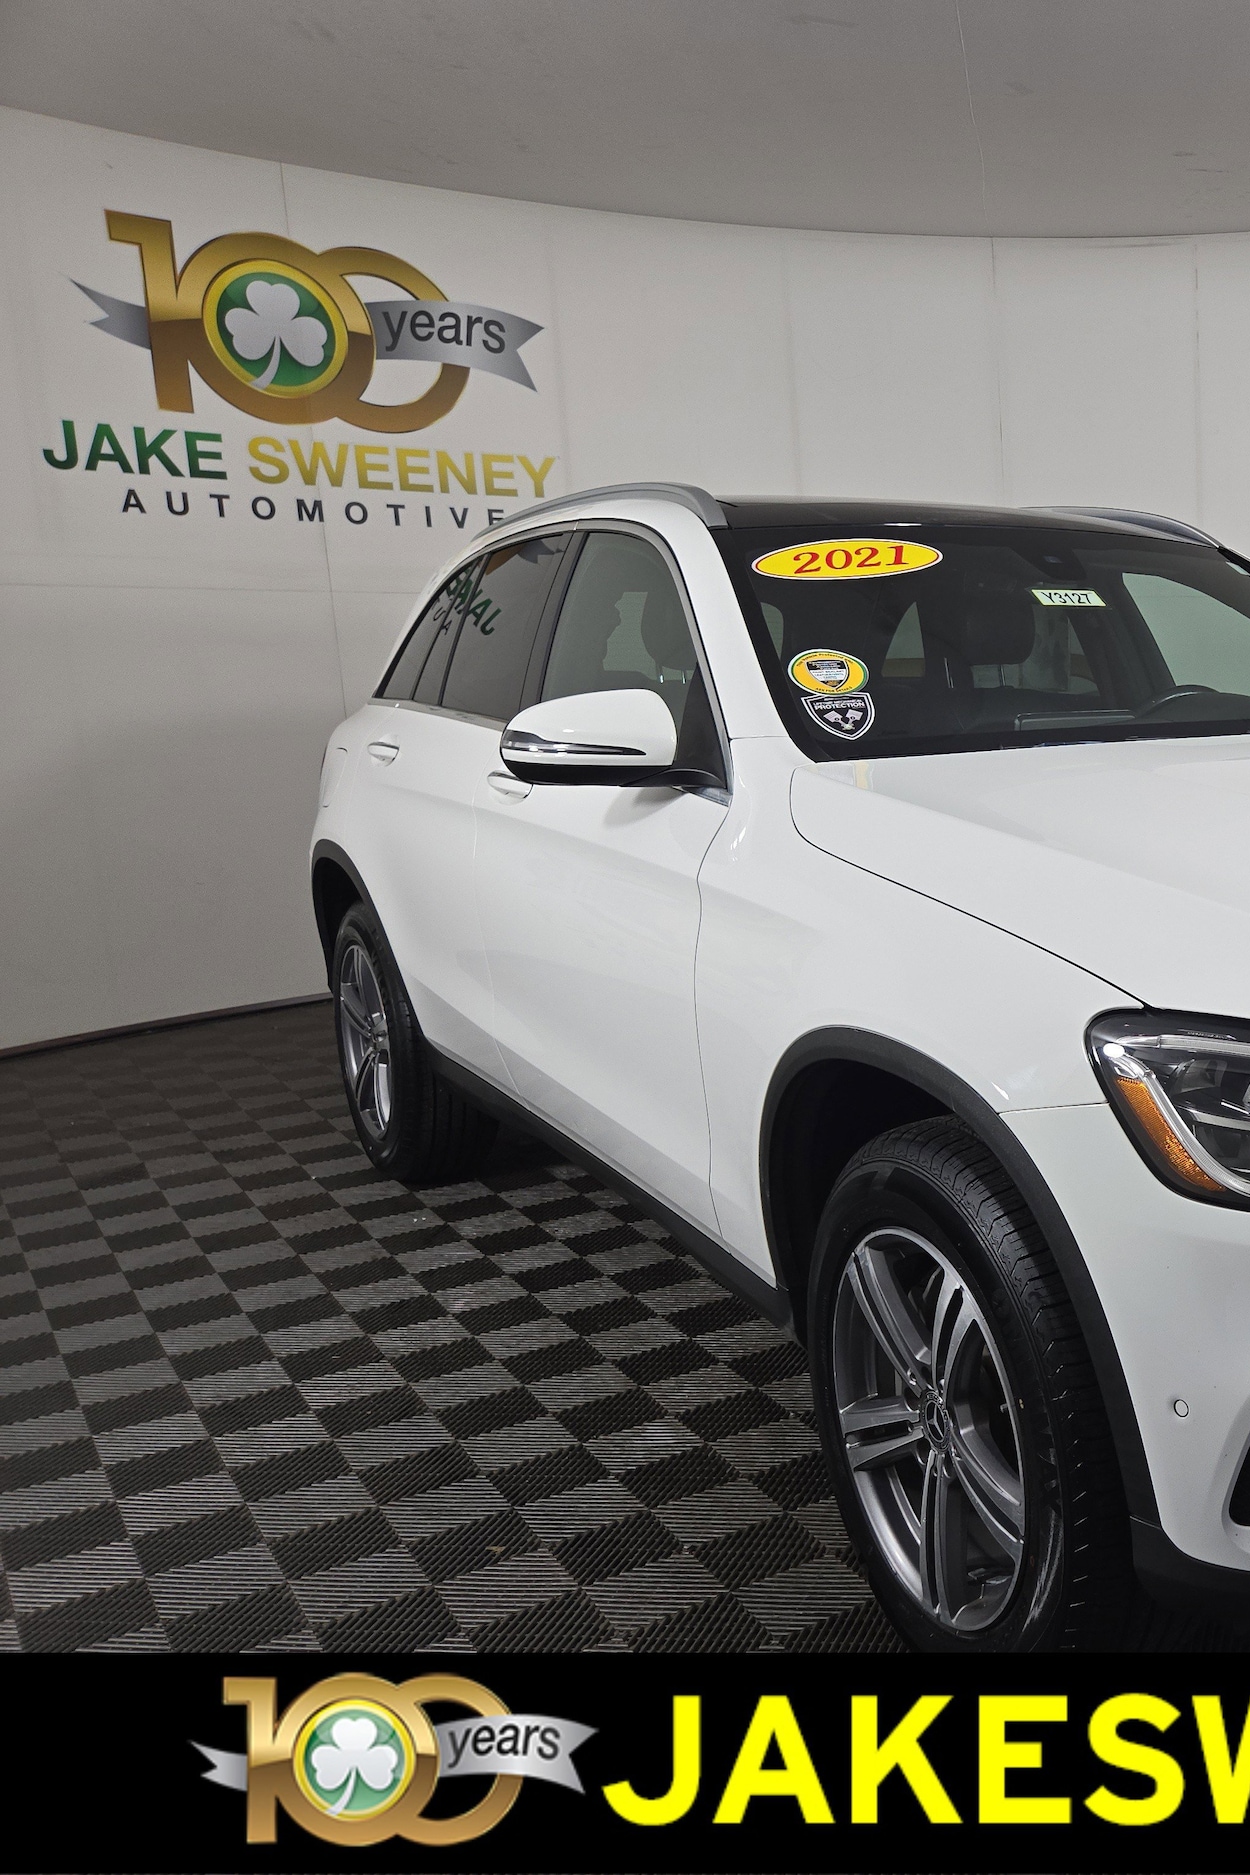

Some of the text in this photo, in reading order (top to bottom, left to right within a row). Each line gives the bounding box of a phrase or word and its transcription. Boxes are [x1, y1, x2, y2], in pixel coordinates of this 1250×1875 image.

[104, 208, 507, 434] 100 years
[43, 419, 557, 499] JAKE SWEENEY
[793, 545, 910, 574] 2021
[1040, 591, 1092, 605] Y3127
[814, 701, 866, 711] PROTECTION
